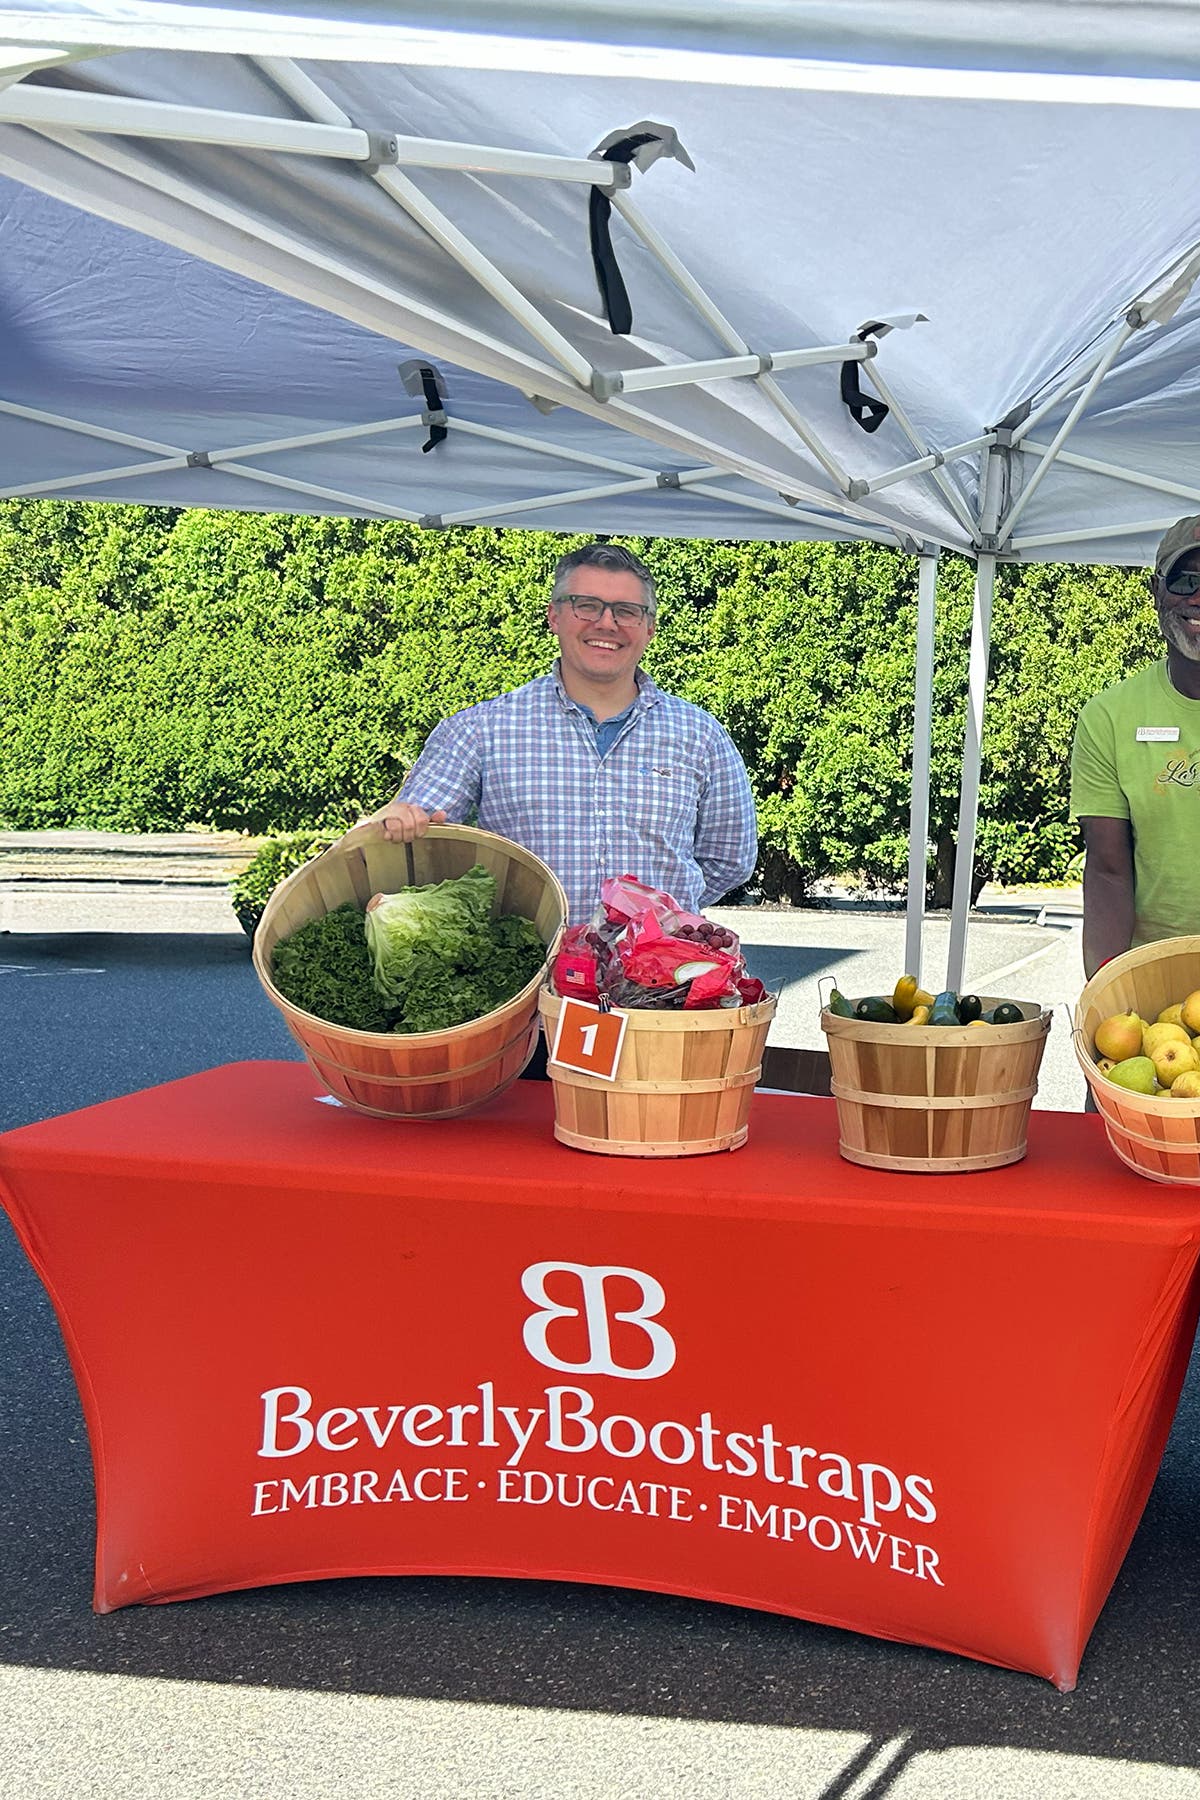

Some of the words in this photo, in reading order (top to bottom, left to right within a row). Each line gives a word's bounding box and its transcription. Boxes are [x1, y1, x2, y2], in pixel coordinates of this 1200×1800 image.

[1158, 760, 1197, 787] Las
[579, 1023, 599, 1057] 1
[250, 1468, 469, 1517] EMBRACE
[496, 1469, 693, 1522] EDUCATE
[718, 1494, 945, 1587] EMPOWER
